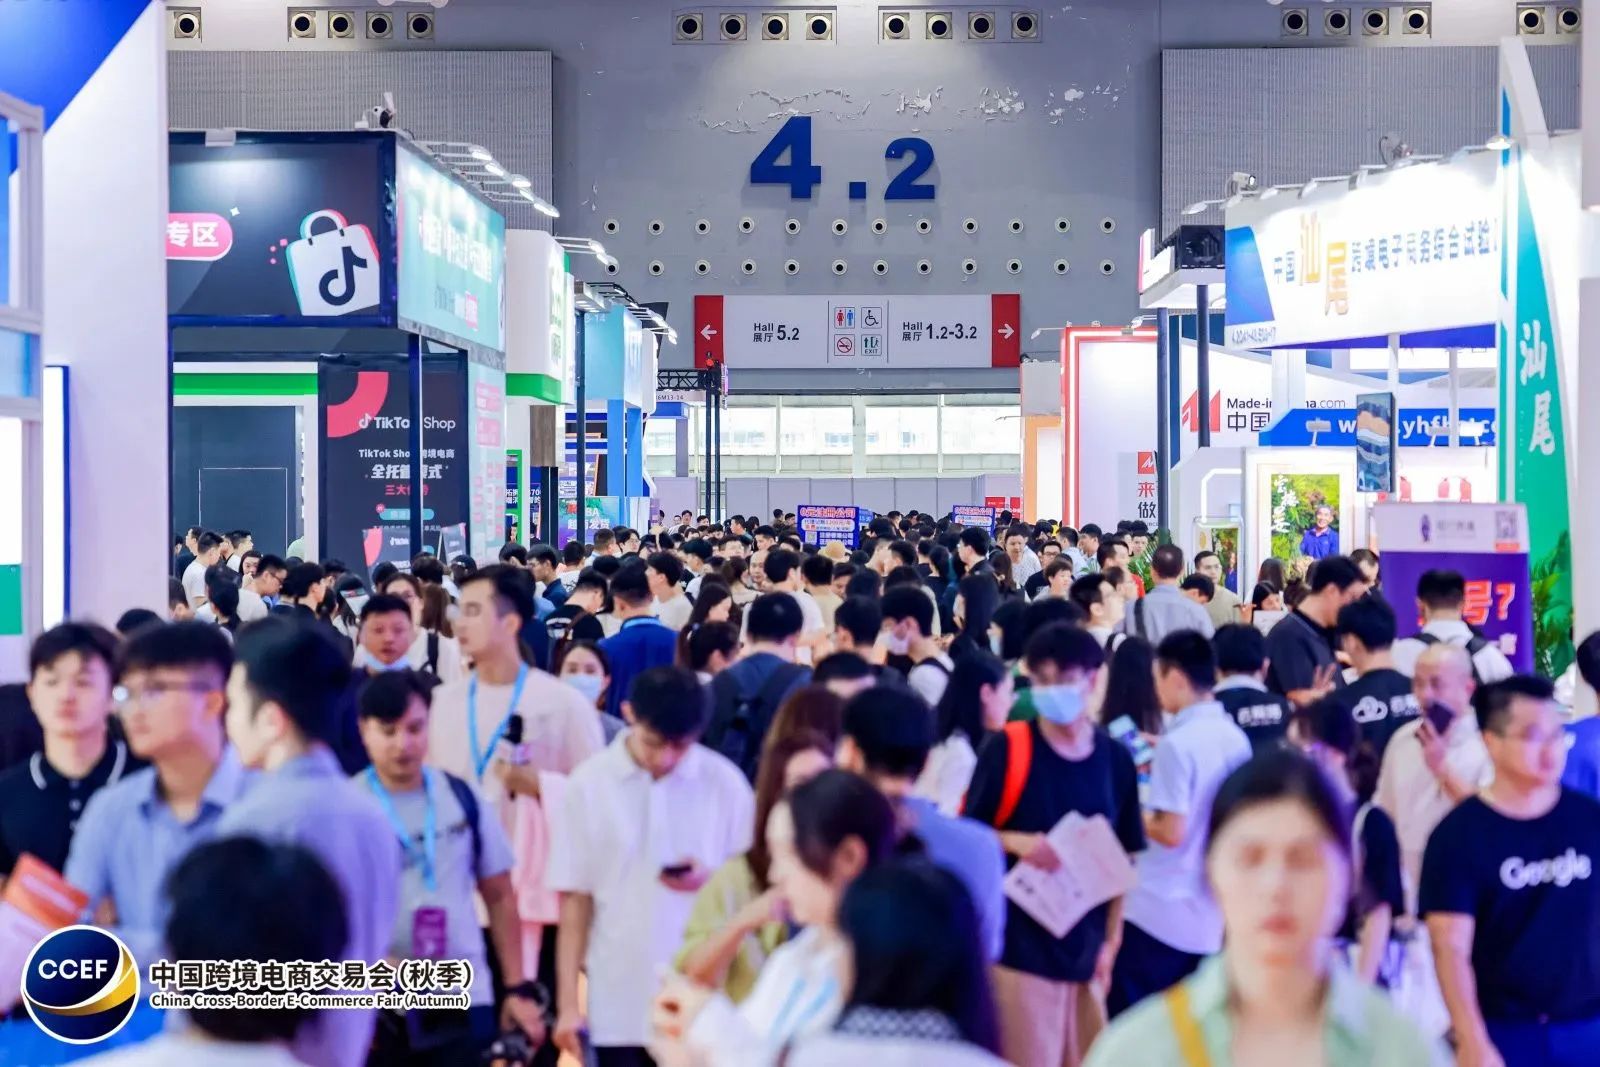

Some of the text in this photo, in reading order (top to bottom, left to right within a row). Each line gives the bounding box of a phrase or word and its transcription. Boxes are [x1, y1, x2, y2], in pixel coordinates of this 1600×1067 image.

[751, 116, 935, 200] 4.2
[753, 323, 800, 341] Hall 5.2
[753, 332, 774, 342] 展厅
[902, 322, 977, 340] Hall 1.2-3.2
[902, 331, 922, 341] 展厅
[373, 416, 456, 433] TikTo Shop
[359, 449, 391, 458] TikTok
[393, 449, 411, 459] Sho
[1138, 501, 1156, 519] 做
[1499, 847, 1592, 890] Google
